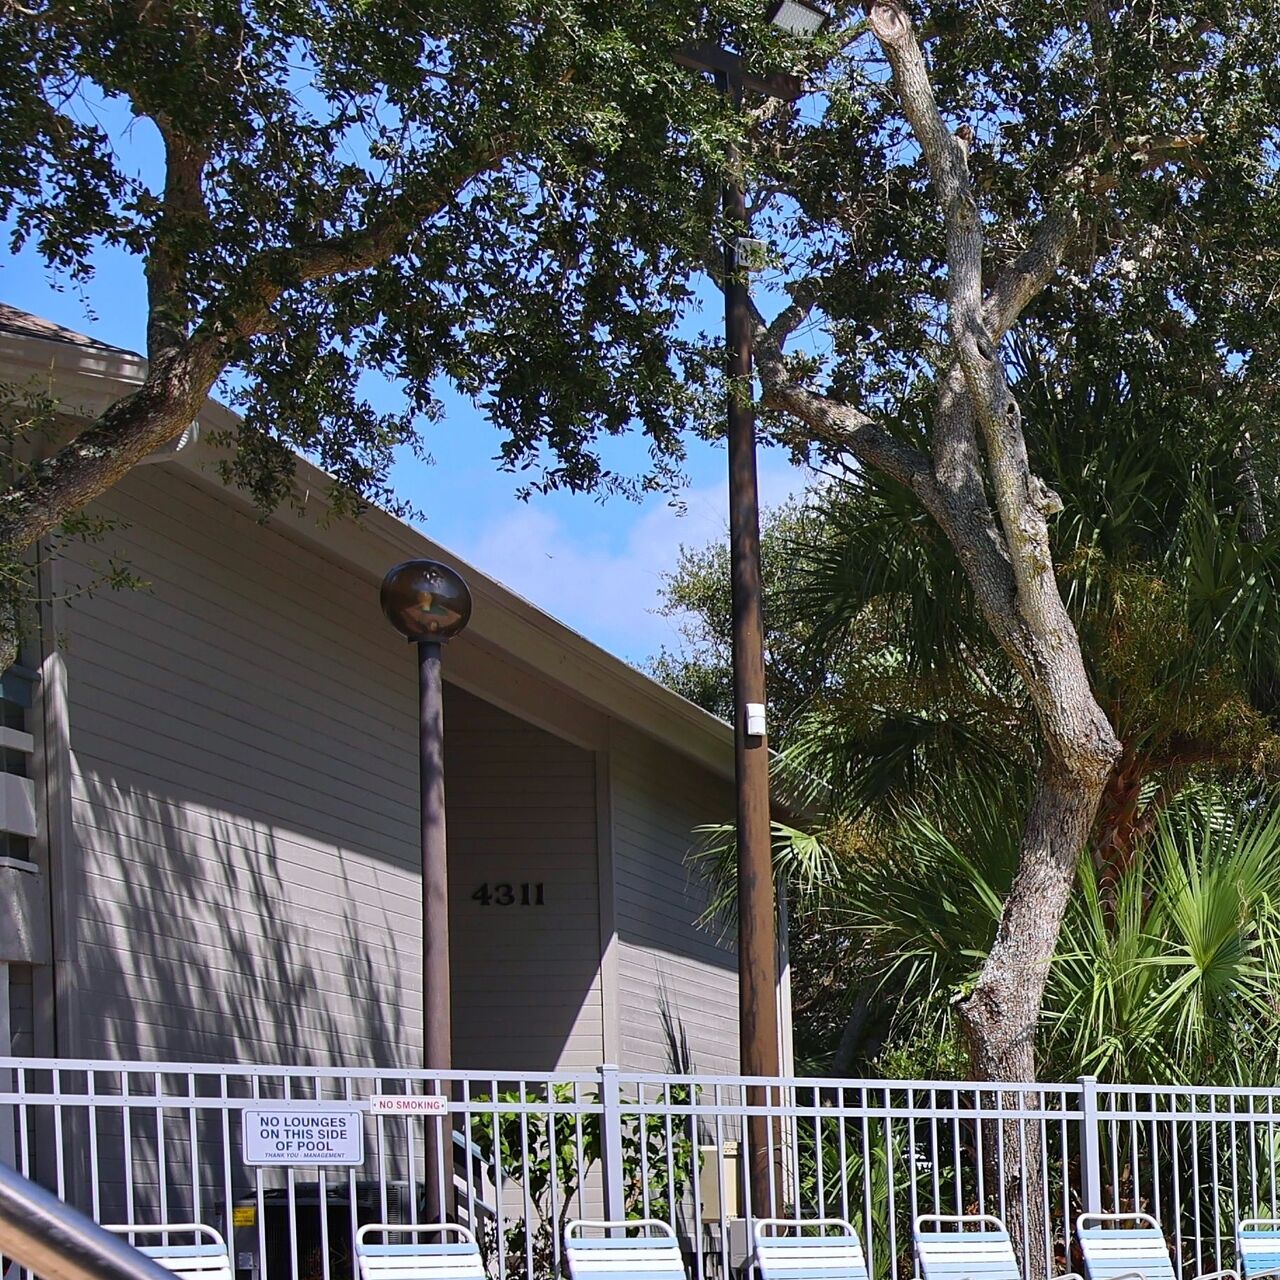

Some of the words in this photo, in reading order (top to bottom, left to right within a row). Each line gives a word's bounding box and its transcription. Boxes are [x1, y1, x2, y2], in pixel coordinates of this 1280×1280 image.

[472, 882, 544, 906] 4311
[379, 1101, 394, 1109] NO
[396, 1101, 440, 1110] SMOKING
[260, 1117, 280, 1127] NO
[284, 1117, 346, 1127] LOUNGES
[260, 1129, 280, 1139] ON
[283, 1129, 314, 1140] THIS
[318, 1129, 348, 1140] SIDE
[275, 1141, 293, 1151] OF
[297, 1141, 334, 1151] POOL
